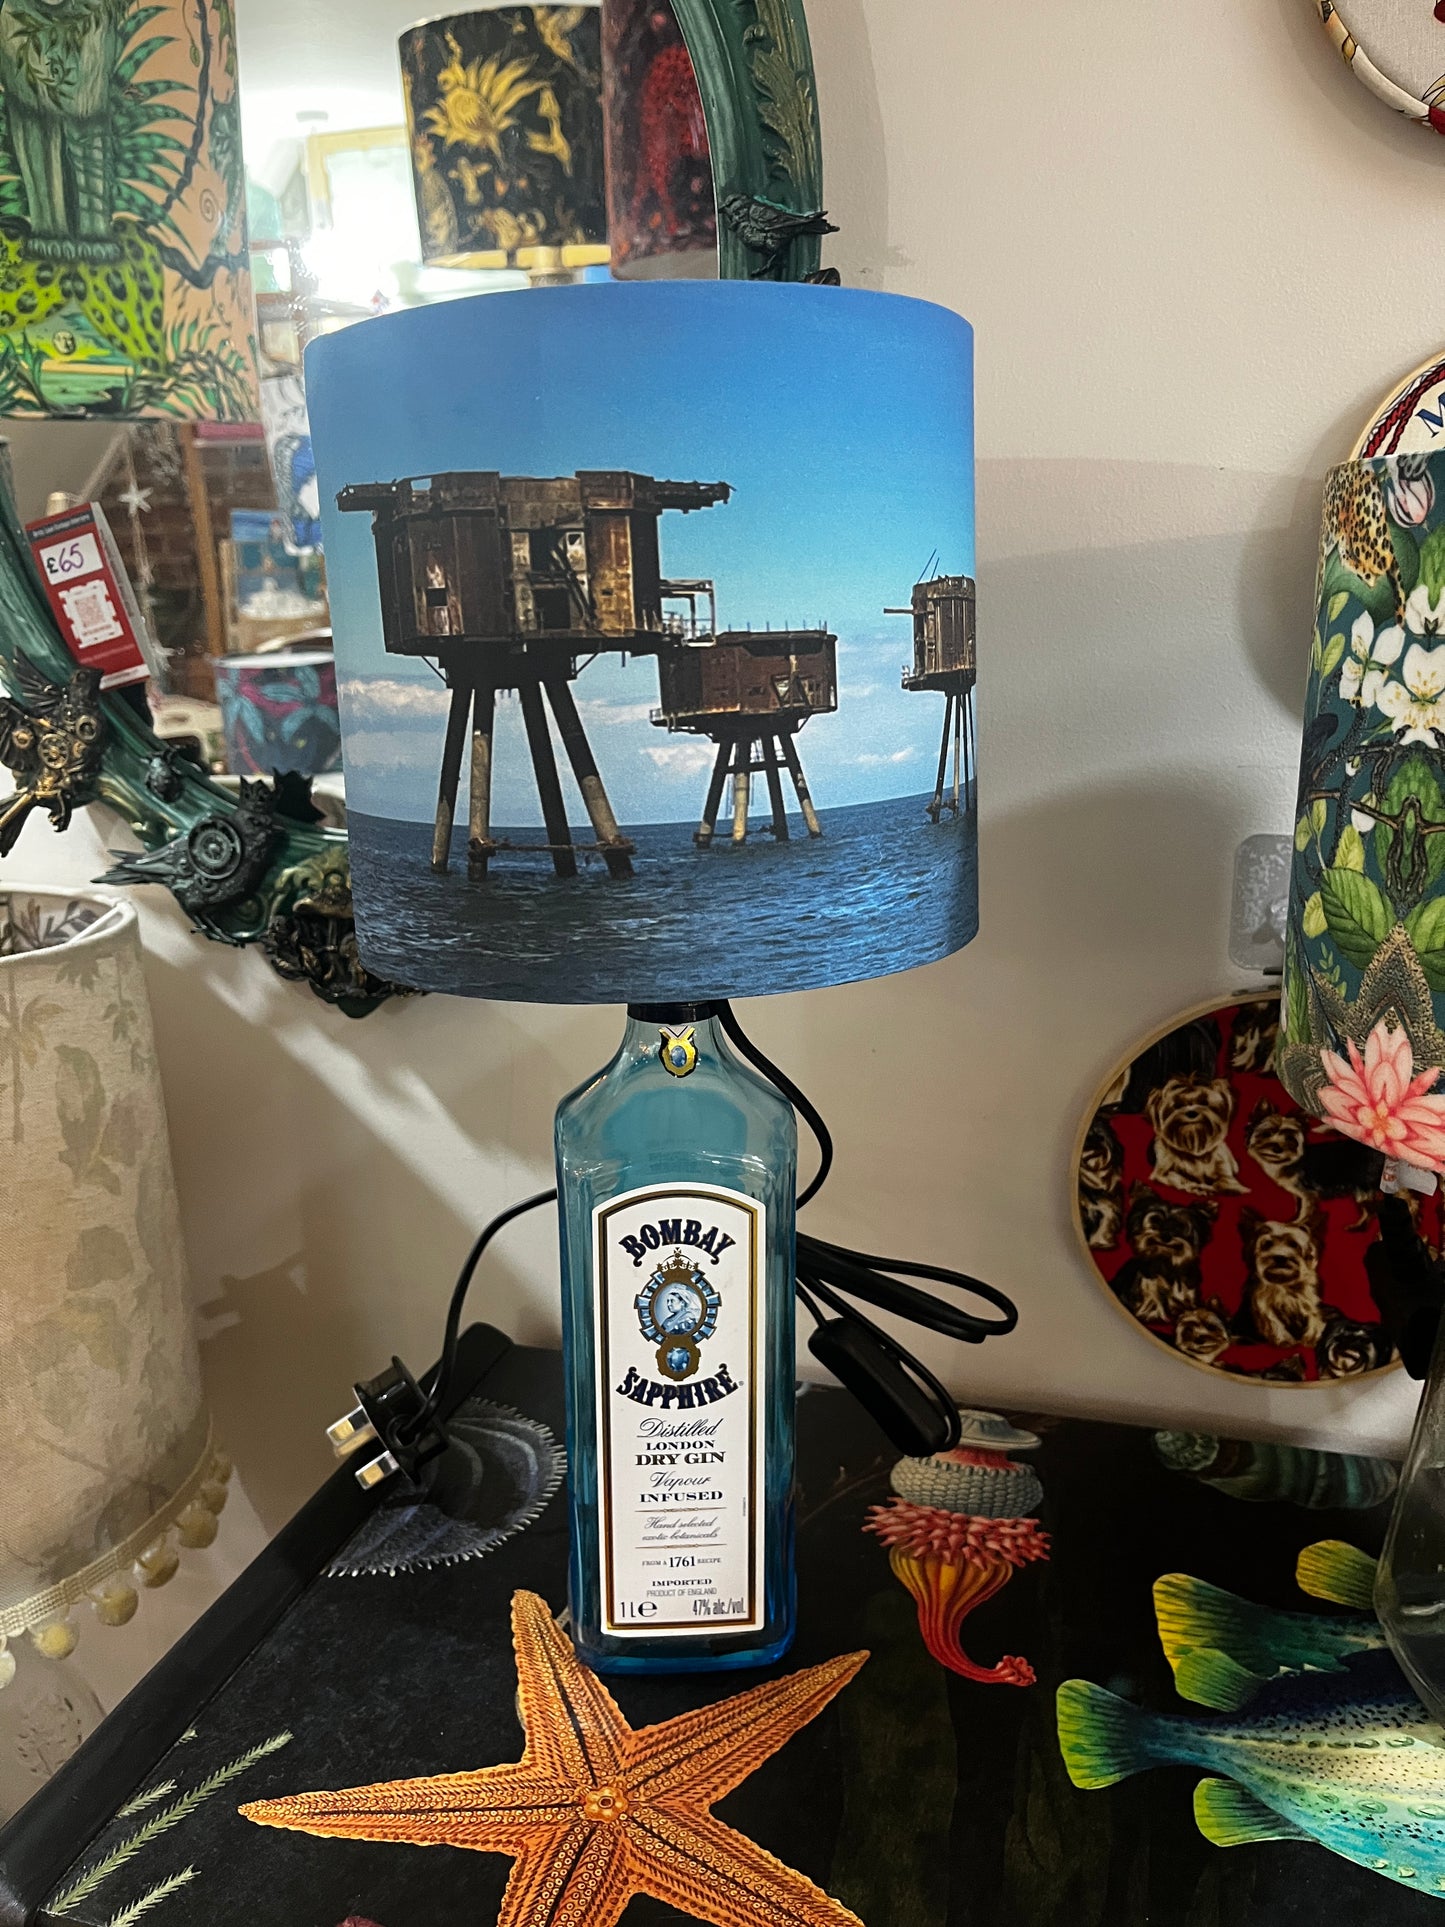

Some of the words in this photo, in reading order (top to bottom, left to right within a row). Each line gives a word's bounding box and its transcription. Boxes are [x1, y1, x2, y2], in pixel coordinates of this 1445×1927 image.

[46, 542, 85, 574] £65
[618, 1218, 736, 1268] BOMBAY
[615, 1362, 740, 1410] SAPPHIRE
[636, 1417, 724, 1438] Distilled
[646, 1440, 715, 1451] LONDON
[635, 1453, 681, 1466] DRY
[684, 1451, 726, 1465] GIN
[649, 1471, 711, 1491] Vapour
[640, 1490, 723, 1503] INFUSED
[644, 1516, 680, 1530] Hand
[678, 1516, 718, 1529] selected
[669, 1555, 696, 1568] 1761
[652, 1578, 712, 1587] IMPORTED
[646, 1589, 676, 1598] PRODUCT
[677, 1588, 687, 1597] OF
[687, 1587, 718, 1596] ENGLAND
[692, 1598, 712, 1616] 47%
